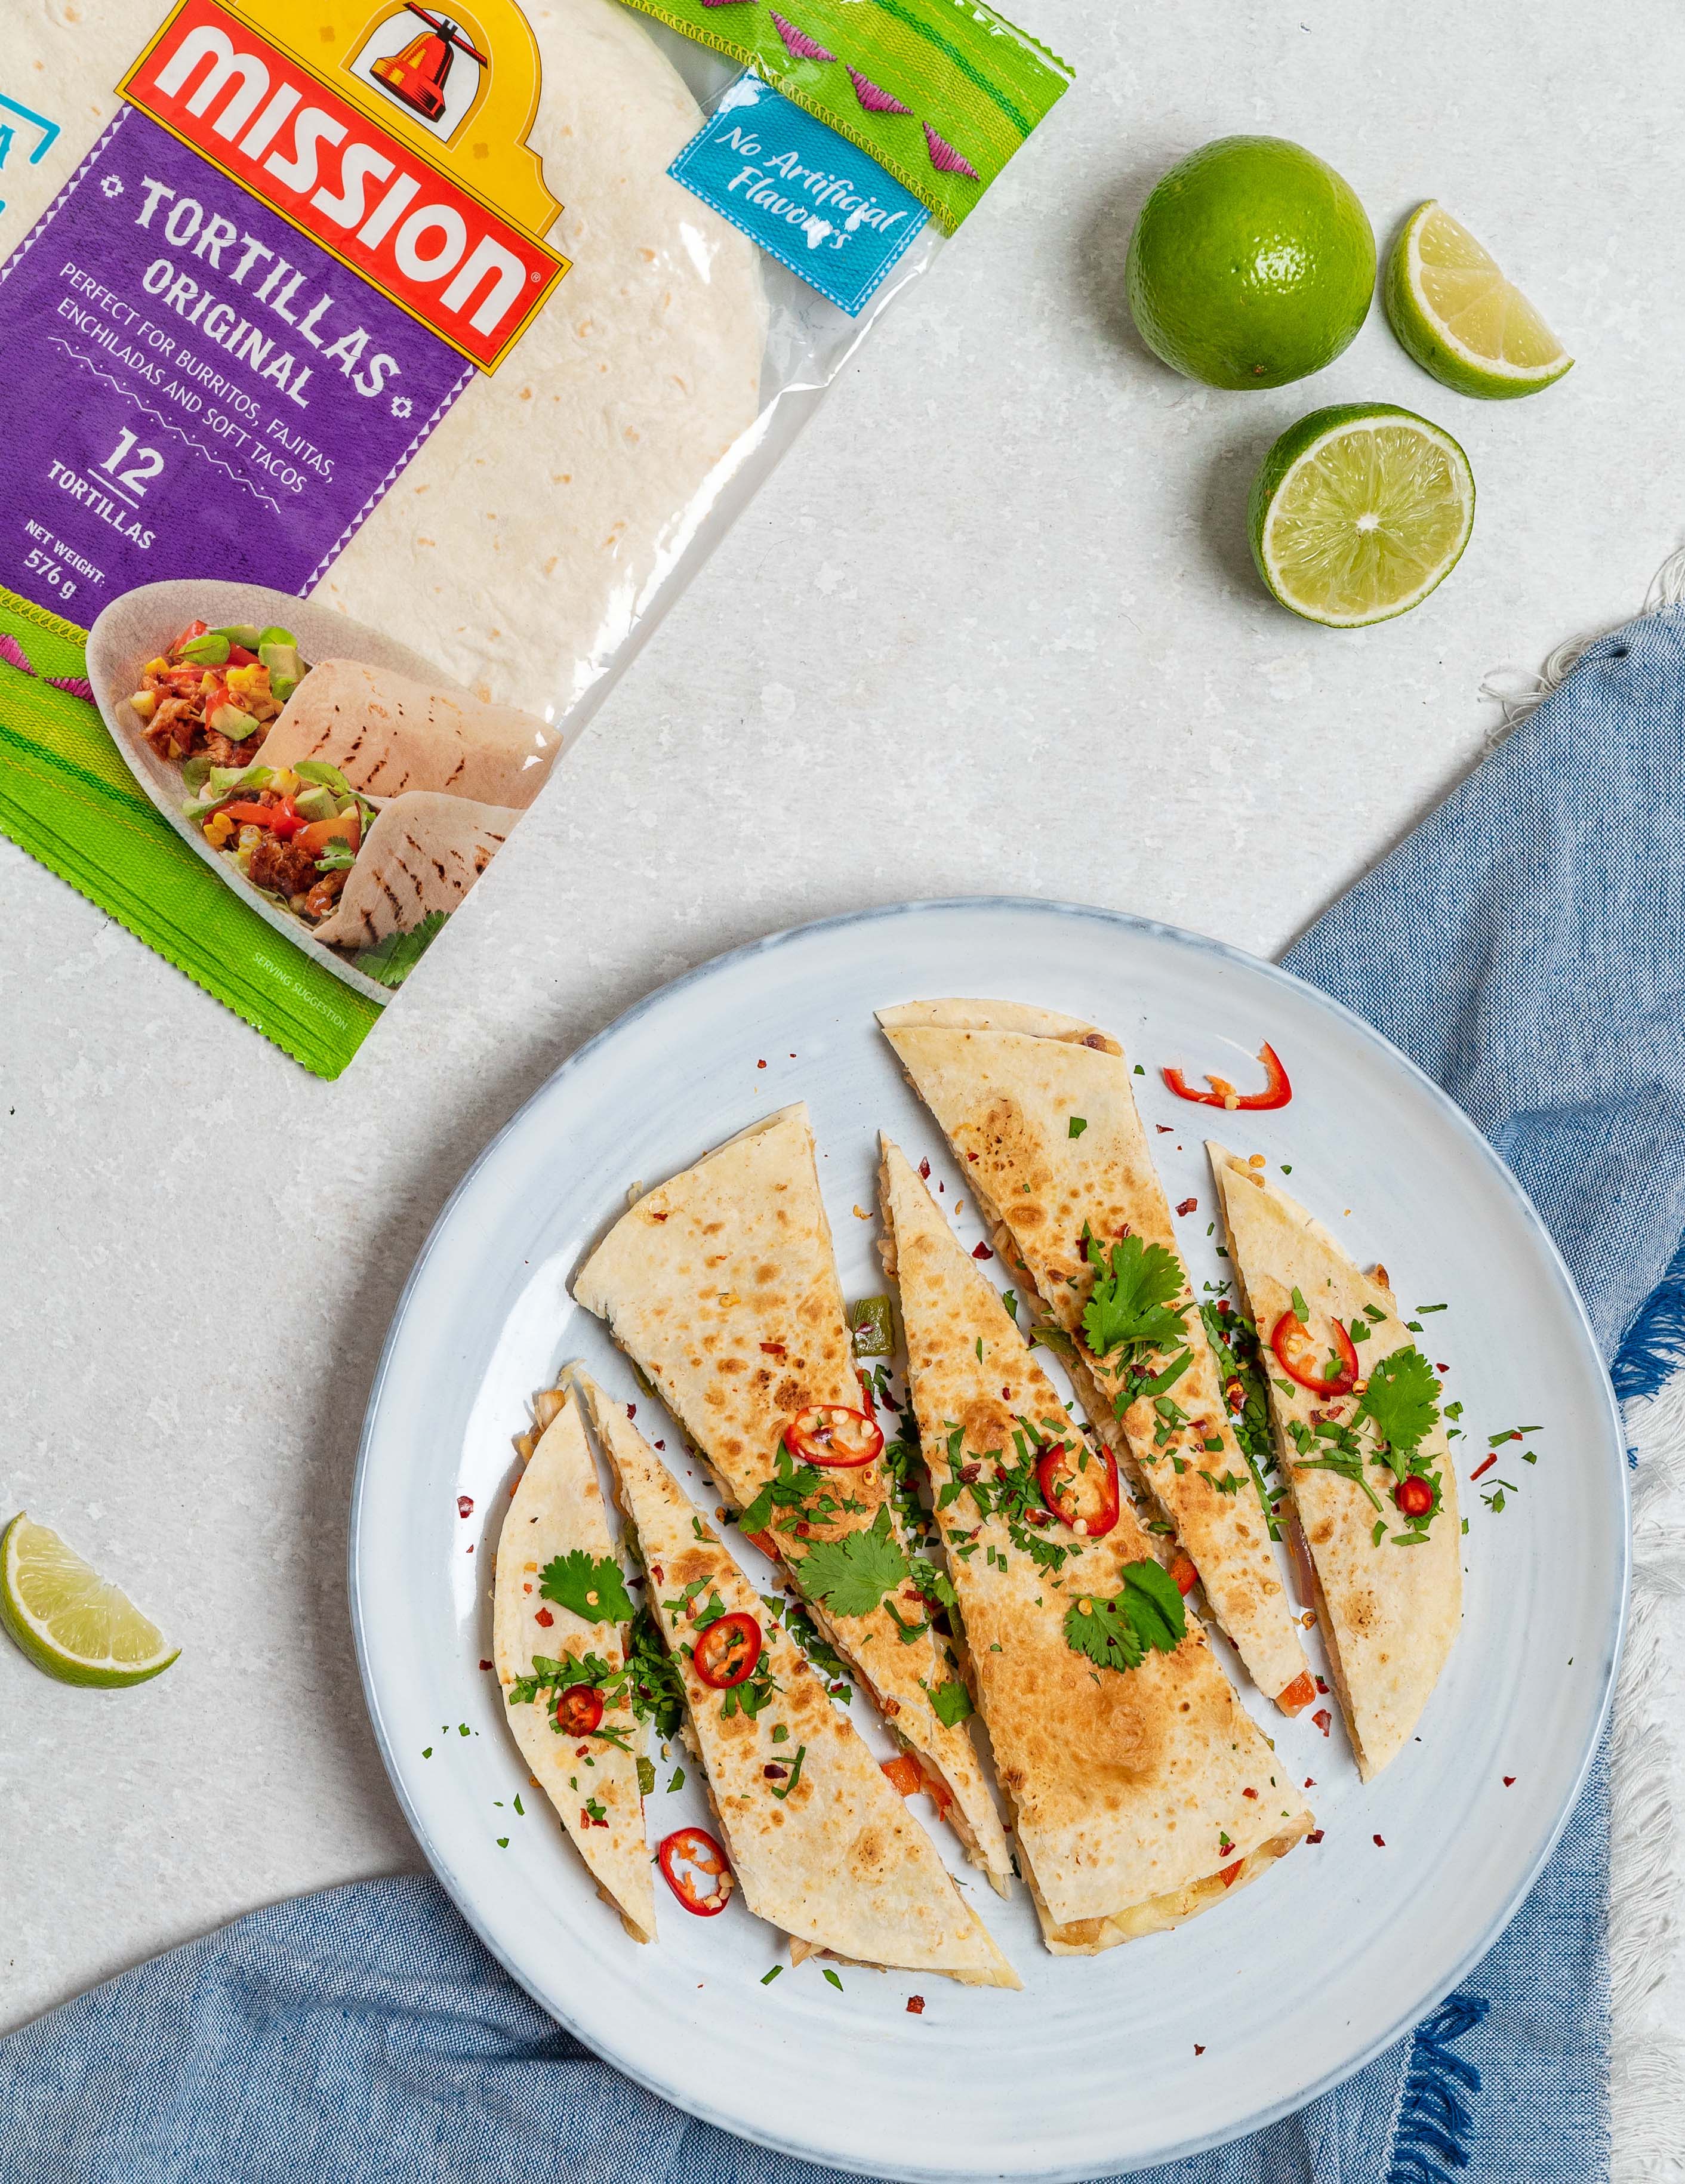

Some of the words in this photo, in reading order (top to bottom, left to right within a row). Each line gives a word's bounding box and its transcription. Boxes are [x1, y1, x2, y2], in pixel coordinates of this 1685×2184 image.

[715, 126, 762, 155] No
[763, 151, 908, 233] Artificial
[134, 174, 402, 394] TORTILLAS
[142, 258, 314, 409] ORIGINAL
[57, 298, 166, 385] ENCHILADAS
[162, 380, 202, 412] AND
[202, 408, 251, 447] SOFT
[251, 441, 307, 493] TACOS
[59, 261, 140, 325] PERFECT
[137, 320, 176, 357] FOR
[175, 349, 261, 427] BURRITOS,
[266, 418, 335, 483] FAJITAS,
[47, 458, 156, 549] TORTILLAS
[99, 426, 164, 497] 12
[23, 548, 63, 585] 576
[58, 581, 77, 599] g
[24, 519, 54, 545] NET
[53, 539, 106, 588] WEIGHT:
[253, 952, 292, 986] SERVING
[292, 982, 348, 1031] SUGGESTION
